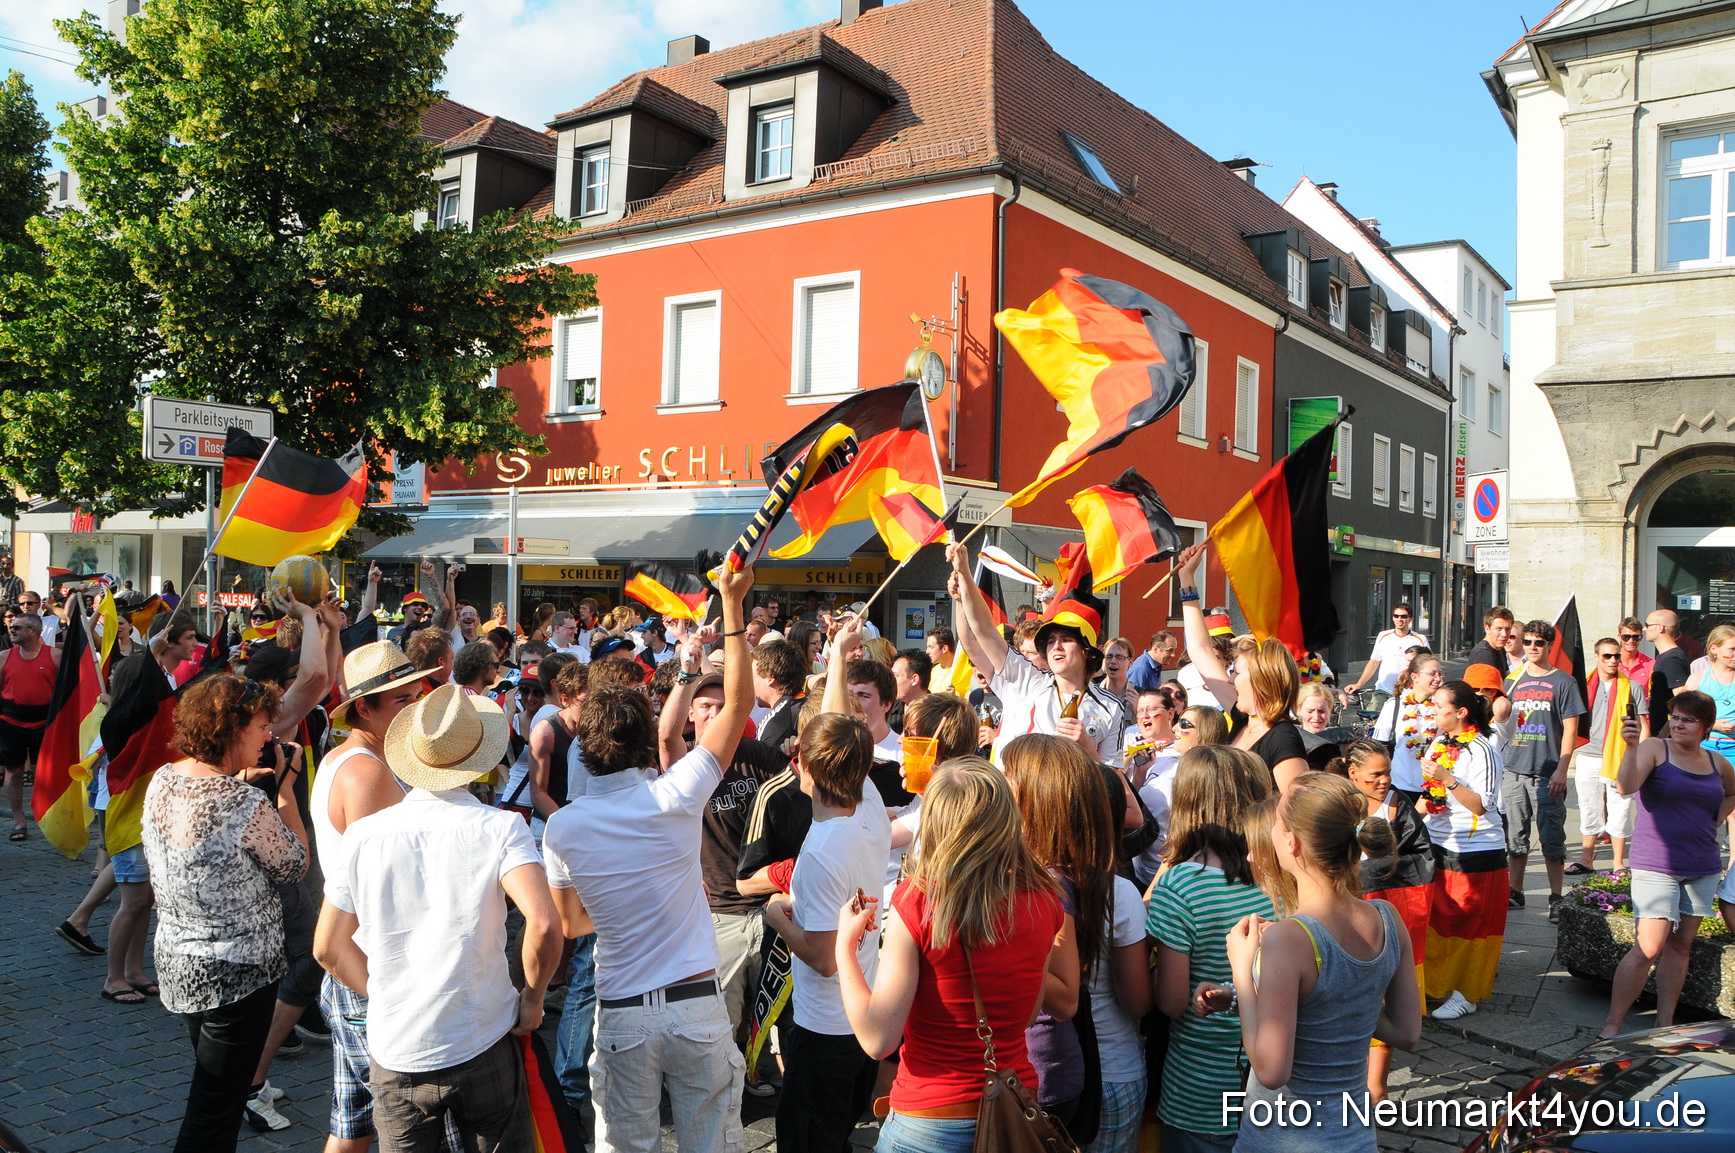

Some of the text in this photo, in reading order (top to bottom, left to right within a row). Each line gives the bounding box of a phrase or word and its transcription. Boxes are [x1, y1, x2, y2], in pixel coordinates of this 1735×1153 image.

[174, 407, 253, 431] Parkleitsystem
[1457, 422, 1467, 456] Reisen
[545, 461, 621, 485] juwelier
[1454, 457, 1466, 498] MERZ
[1475, 526, 1497, 537] ZONE
[560, 568, 620, 580] SCHLIERF
[805, 572, 884, 584] SCHLIERF
[523, 588, 531, 597] 20
[531, 588, 545, 597] Jahre
[238, 595, 255, 606] SAL
[1513, 688, 1553, 700] SEÑOR
